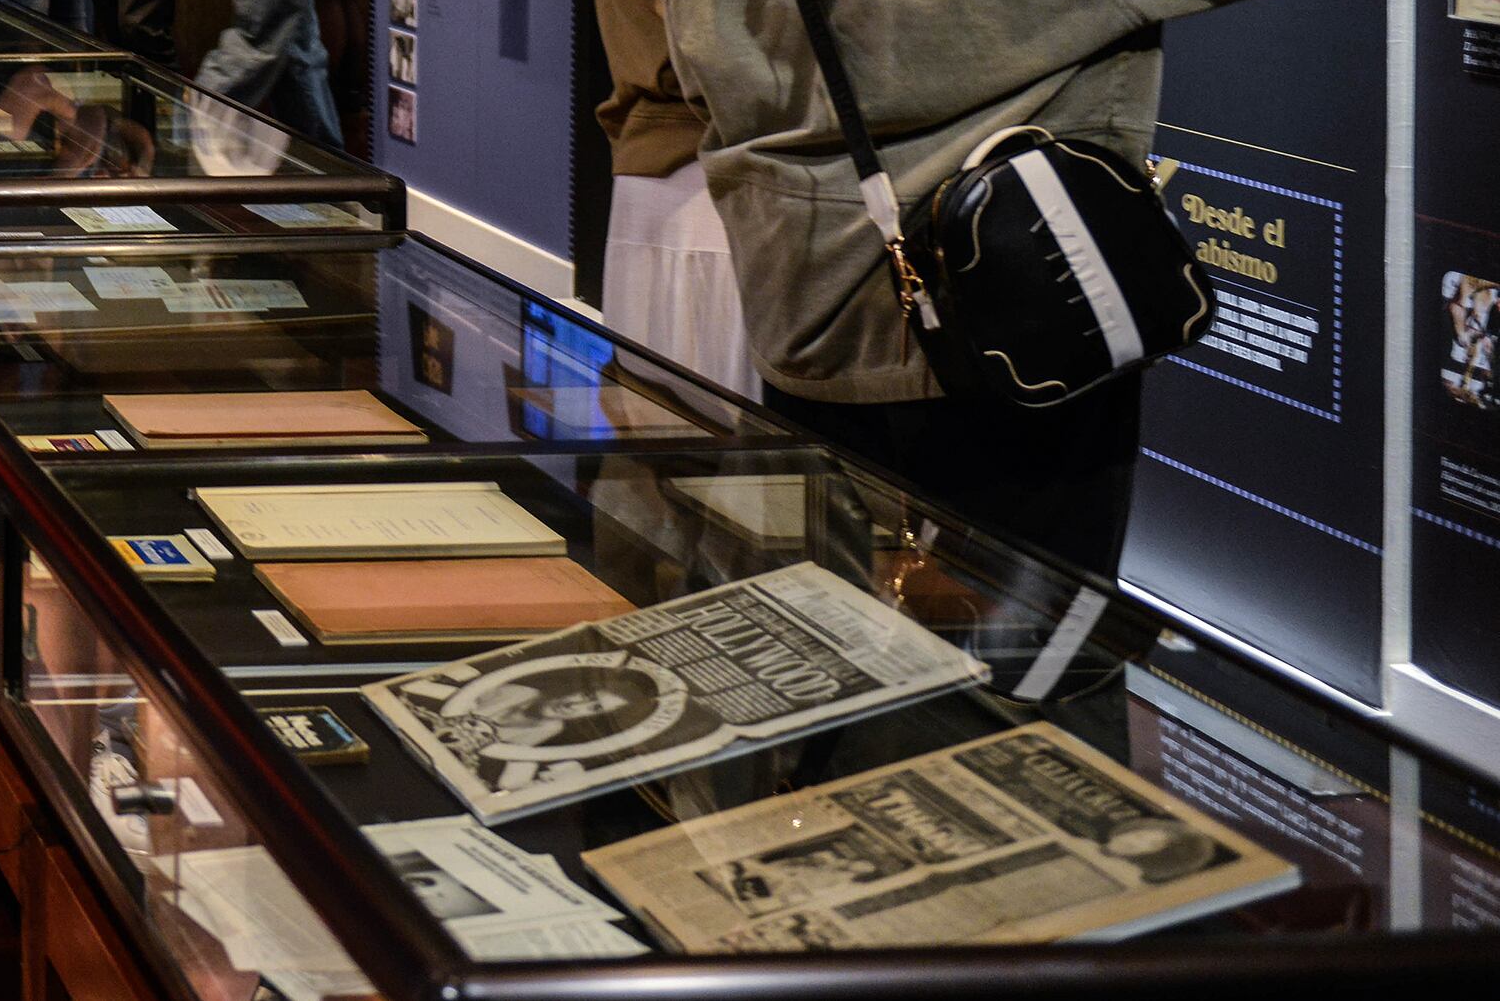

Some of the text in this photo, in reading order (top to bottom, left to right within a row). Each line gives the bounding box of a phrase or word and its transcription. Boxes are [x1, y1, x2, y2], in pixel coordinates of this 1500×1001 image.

[1181, 193, 1286, 248] Desde el
[1195, 237, 1278, 285] abismo
[677, 599, 841, 702] HOLLYWOOD
